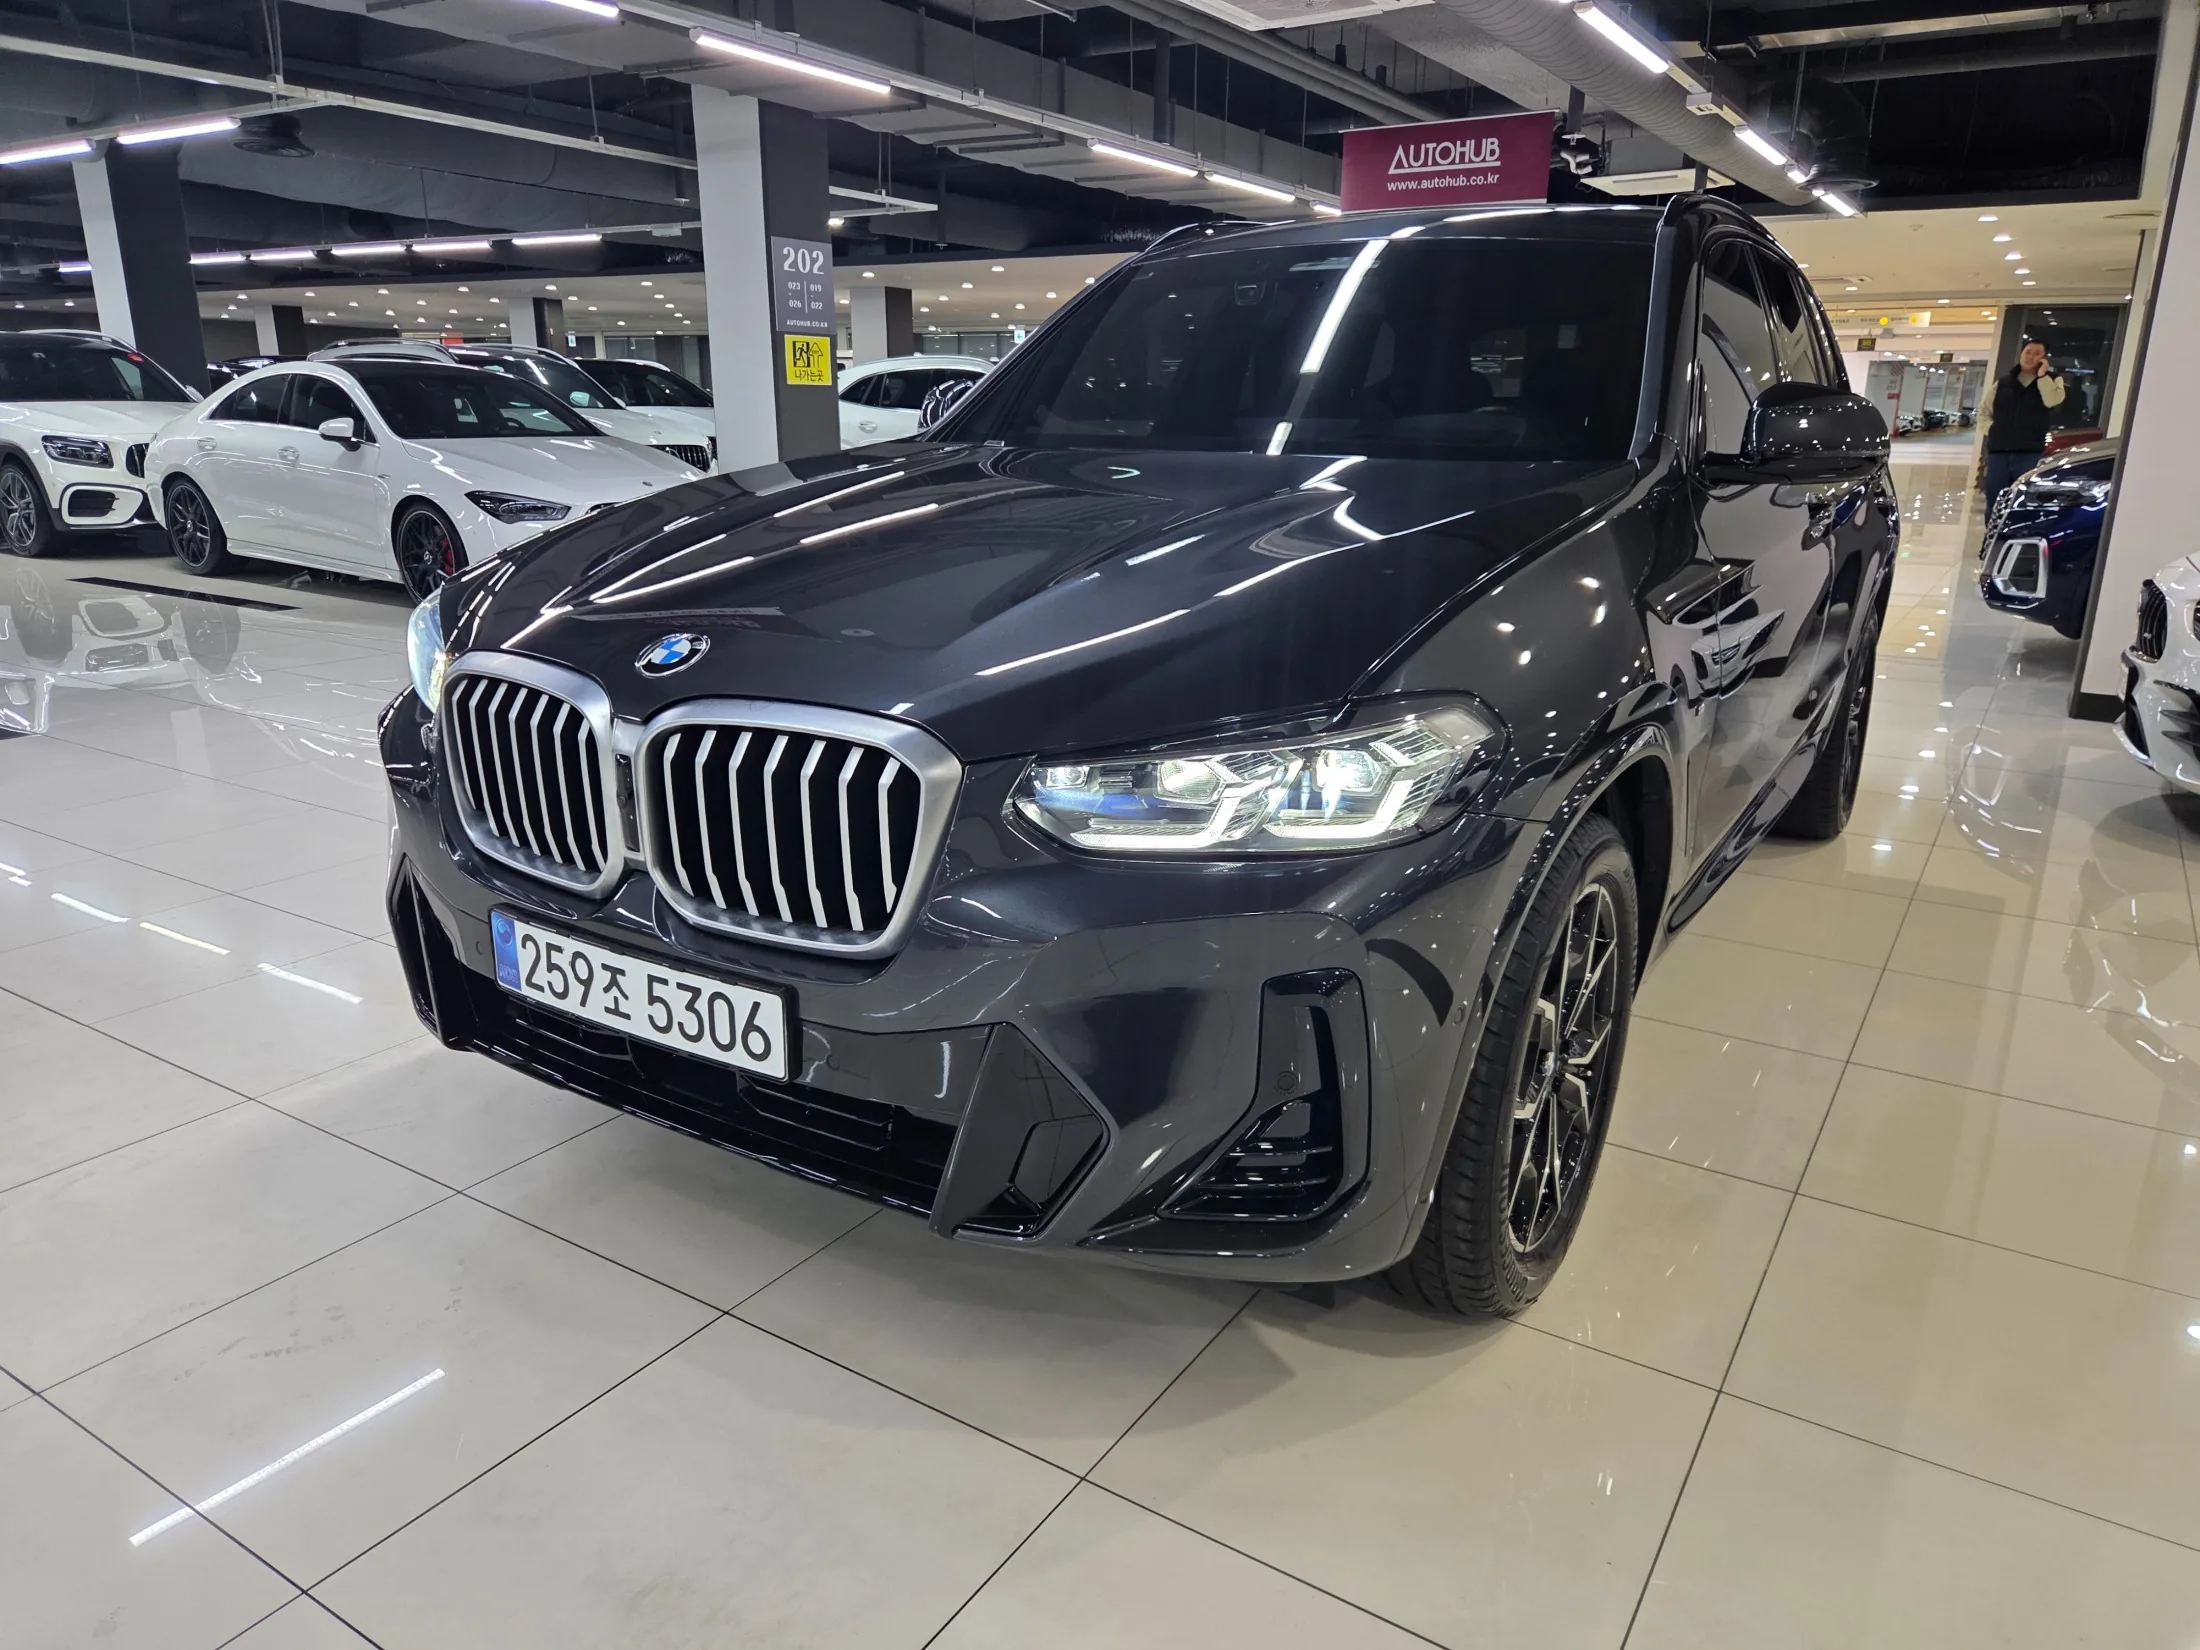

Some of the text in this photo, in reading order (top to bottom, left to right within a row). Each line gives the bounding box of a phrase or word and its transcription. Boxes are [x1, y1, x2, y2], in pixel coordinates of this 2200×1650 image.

[1388, 138, 1501, 174] AUTOHUB
[1387, 173, 1500, 192] www.autohub.co.kr
[782, 246, 825, 275] 202
[788, 281, 801, 290] 023
[809, 283, 822, 292] 019
[789, 299, 802, 308] 026
[810, 301, 823, 310] 022
[786, 319, 828, 328] AUTOHUB.CO.KR
[794, 369, 824, 382] 나가는곳
[521, 933, 772, 1062] 259조 5306
